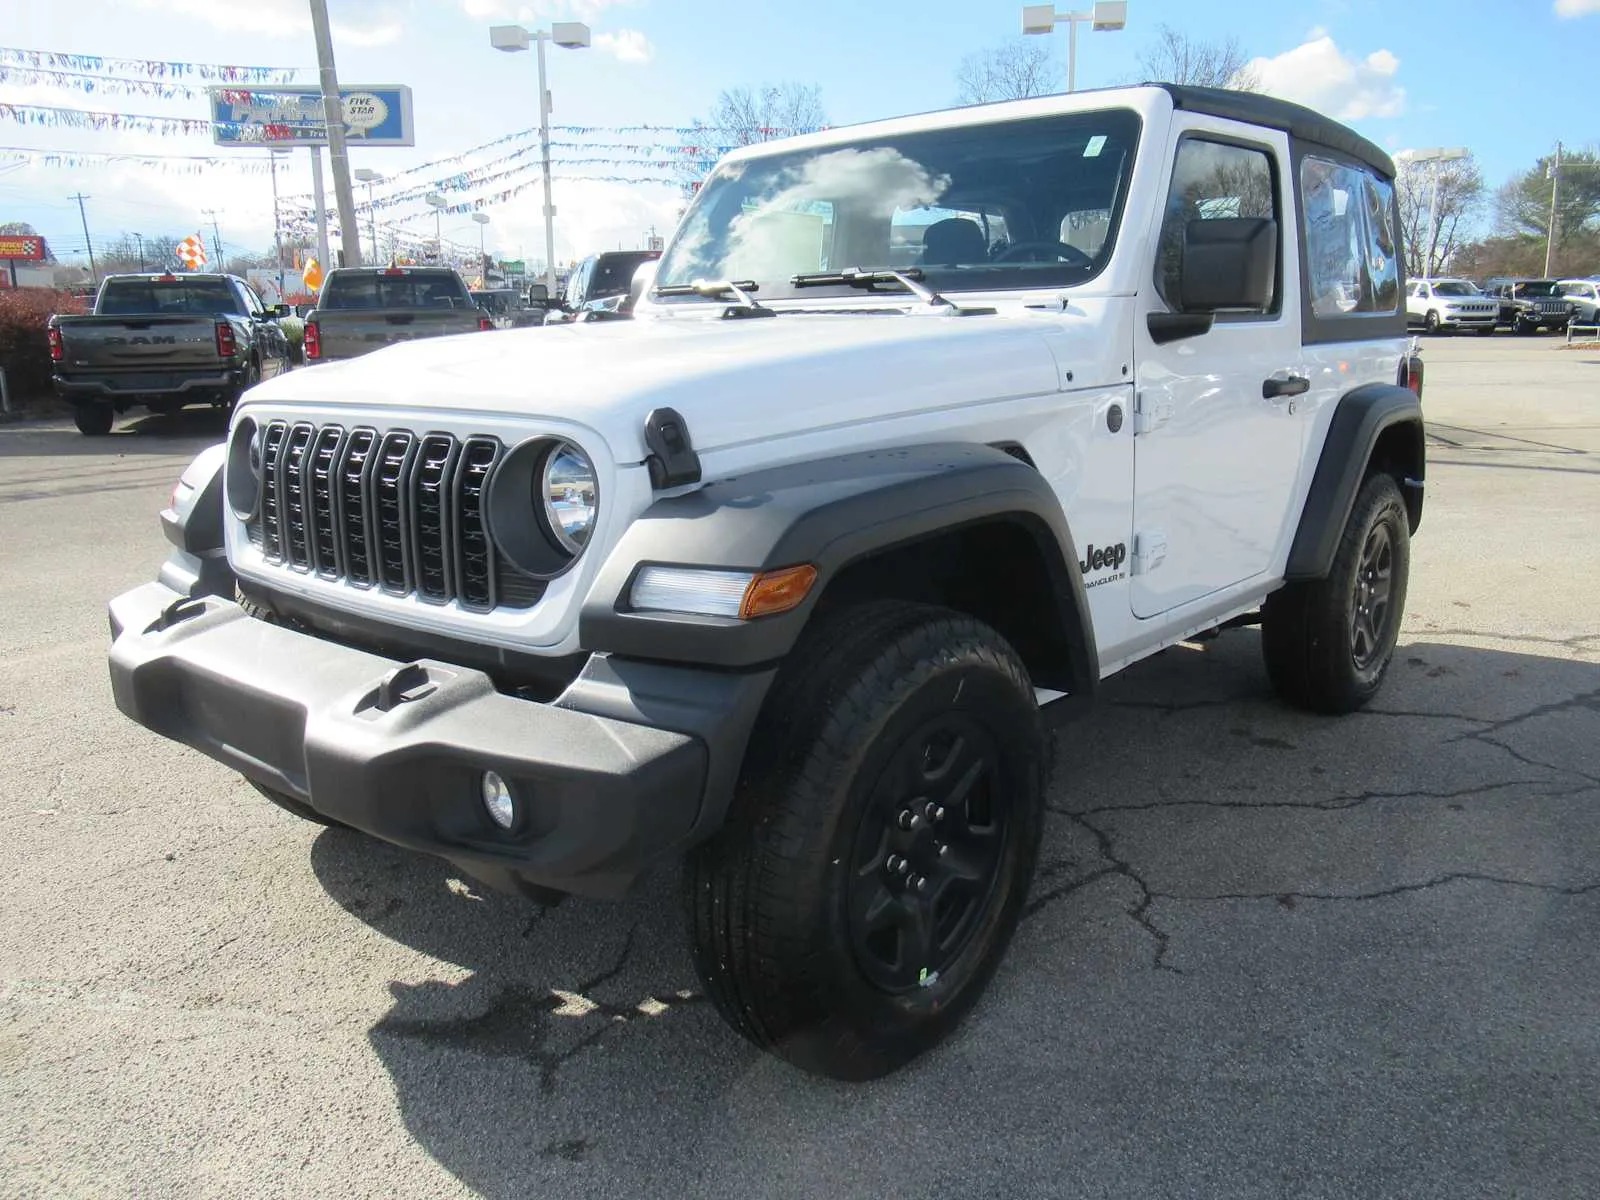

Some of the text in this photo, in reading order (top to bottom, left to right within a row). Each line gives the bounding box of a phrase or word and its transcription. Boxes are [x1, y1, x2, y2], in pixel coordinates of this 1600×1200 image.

[349, 97, 371, 105] FIVE
[350, 106, 374, 114] STAR
[104, 336, 175, 345] RAM
[1079, 543, 1126, 574] Jeep
